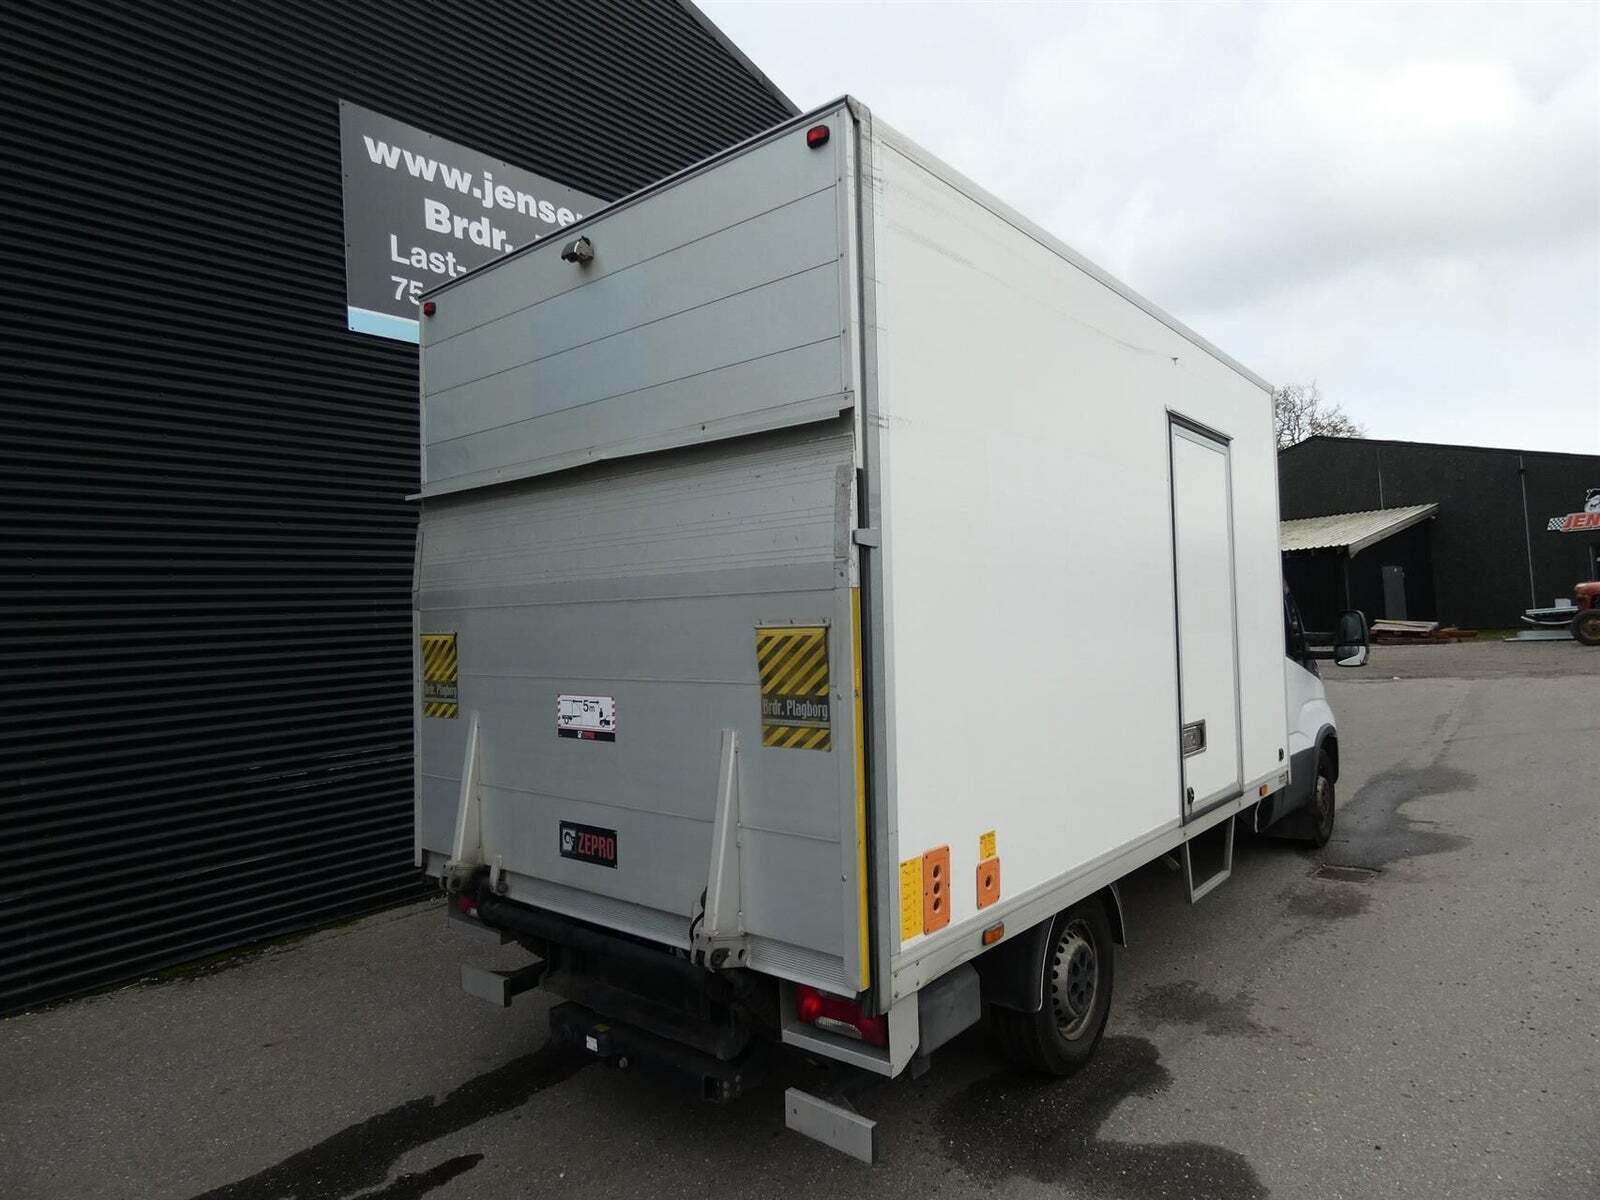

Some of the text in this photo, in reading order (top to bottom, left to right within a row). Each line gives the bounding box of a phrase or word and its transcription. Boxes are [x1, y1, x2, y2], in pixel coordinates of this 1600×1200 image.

[363, 135, 583, 228] www.jense
[424, 198, 514, 253] Brdr.
[390, 234, 467, 277] Last-
[786, 699, 828, 720] Plagborg
[578, 832, 615, 860] ZEPRO
